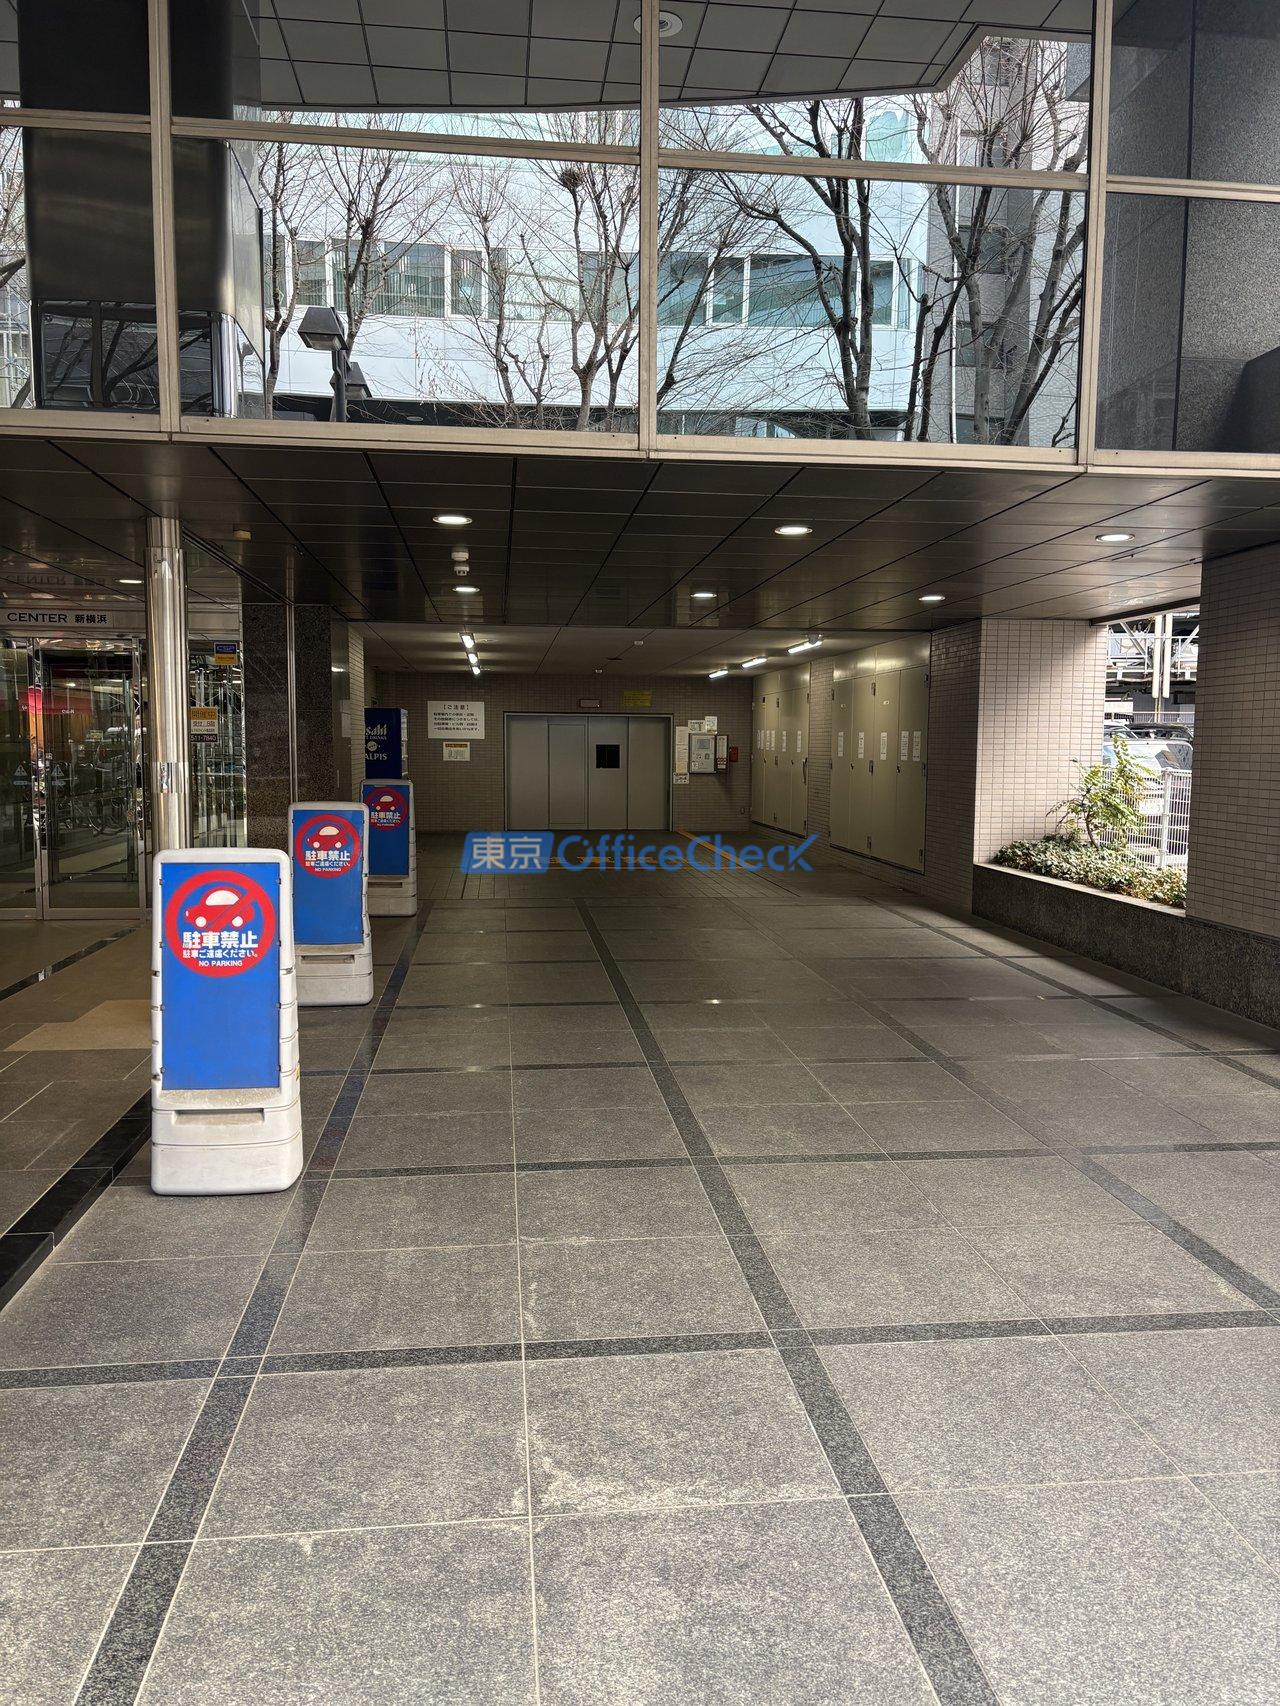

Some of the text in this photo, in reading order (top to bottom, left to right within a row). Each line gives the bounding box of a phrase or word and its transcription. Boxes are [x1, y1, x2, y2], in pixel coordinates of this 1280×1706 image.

[7, 612, 107, 624] CENTER 新横浜
[365, 724, 387, 736] sahi
[364, 753, 388, 761] ALPIS
[305, 850, 351, 861] 駐車禁止
[182, 931, 259, 949] 駐車禁止
